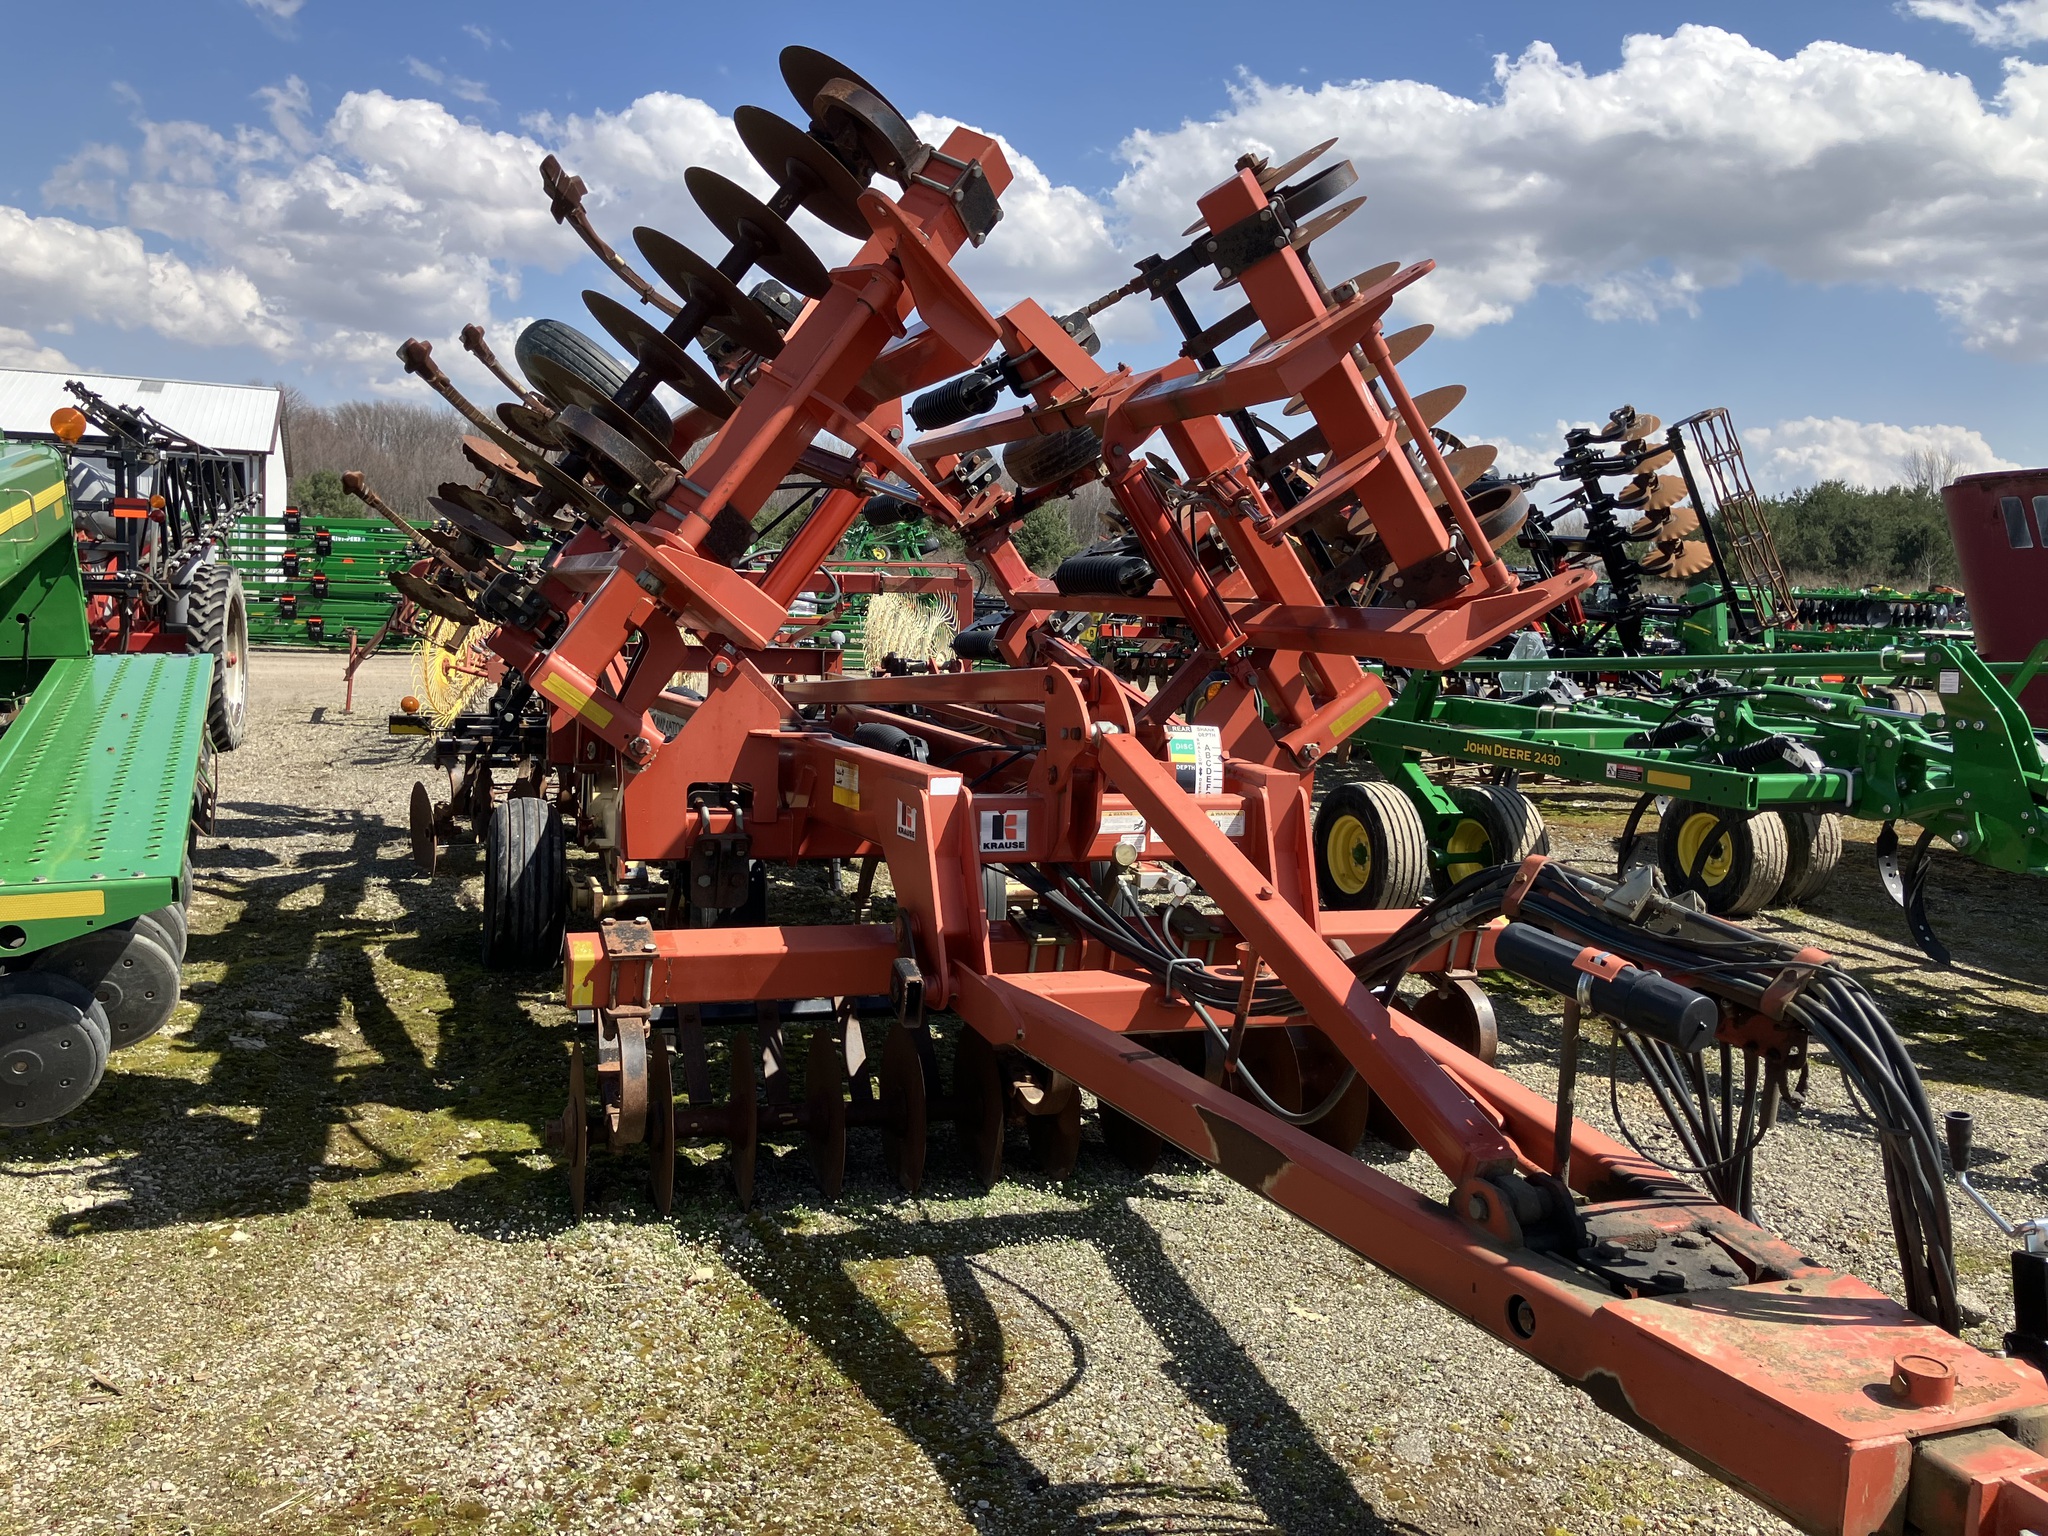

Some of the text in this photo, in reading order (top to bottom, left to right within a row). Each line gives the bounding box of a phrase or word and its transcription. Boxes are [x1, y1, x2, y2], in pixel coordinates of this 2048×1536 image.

[1463, 739, 1561, 767] JOHN DEERE 2430
[898, 826, 915, 839] KRAUSE
[983, 841, 1025, 850] KRAUSE
